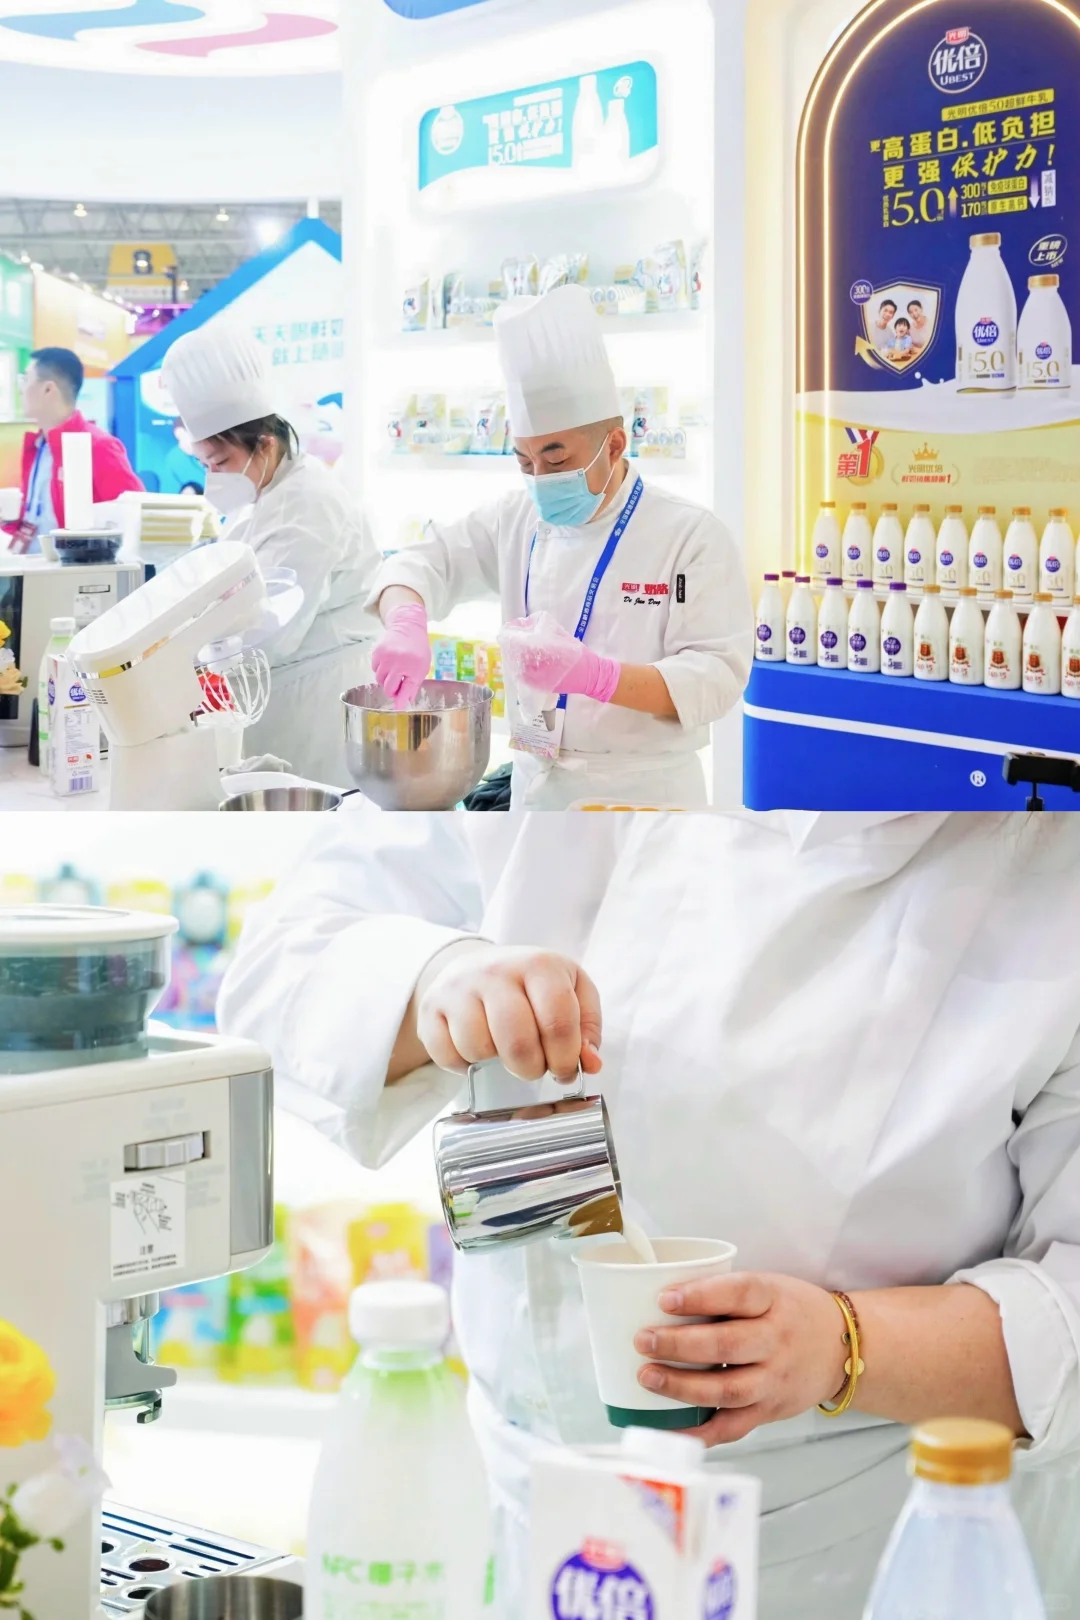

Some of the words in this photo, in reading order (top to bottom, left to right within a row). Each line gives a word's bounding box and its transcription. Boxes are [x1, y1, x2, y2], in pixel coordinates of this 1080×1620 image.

[933, 43, 982, 75] 优倍
[940, 71, 975, 86] UBEST
[961, 183, 980, 199] 300
[891, 188, 945, 227] 5.0
[961, 202, 980, 218] 170
[1033, 251, 1058, 261] 上市
[974, 324, 997, 338] 优倍
[973, 350, 1005, 373] 5.0
